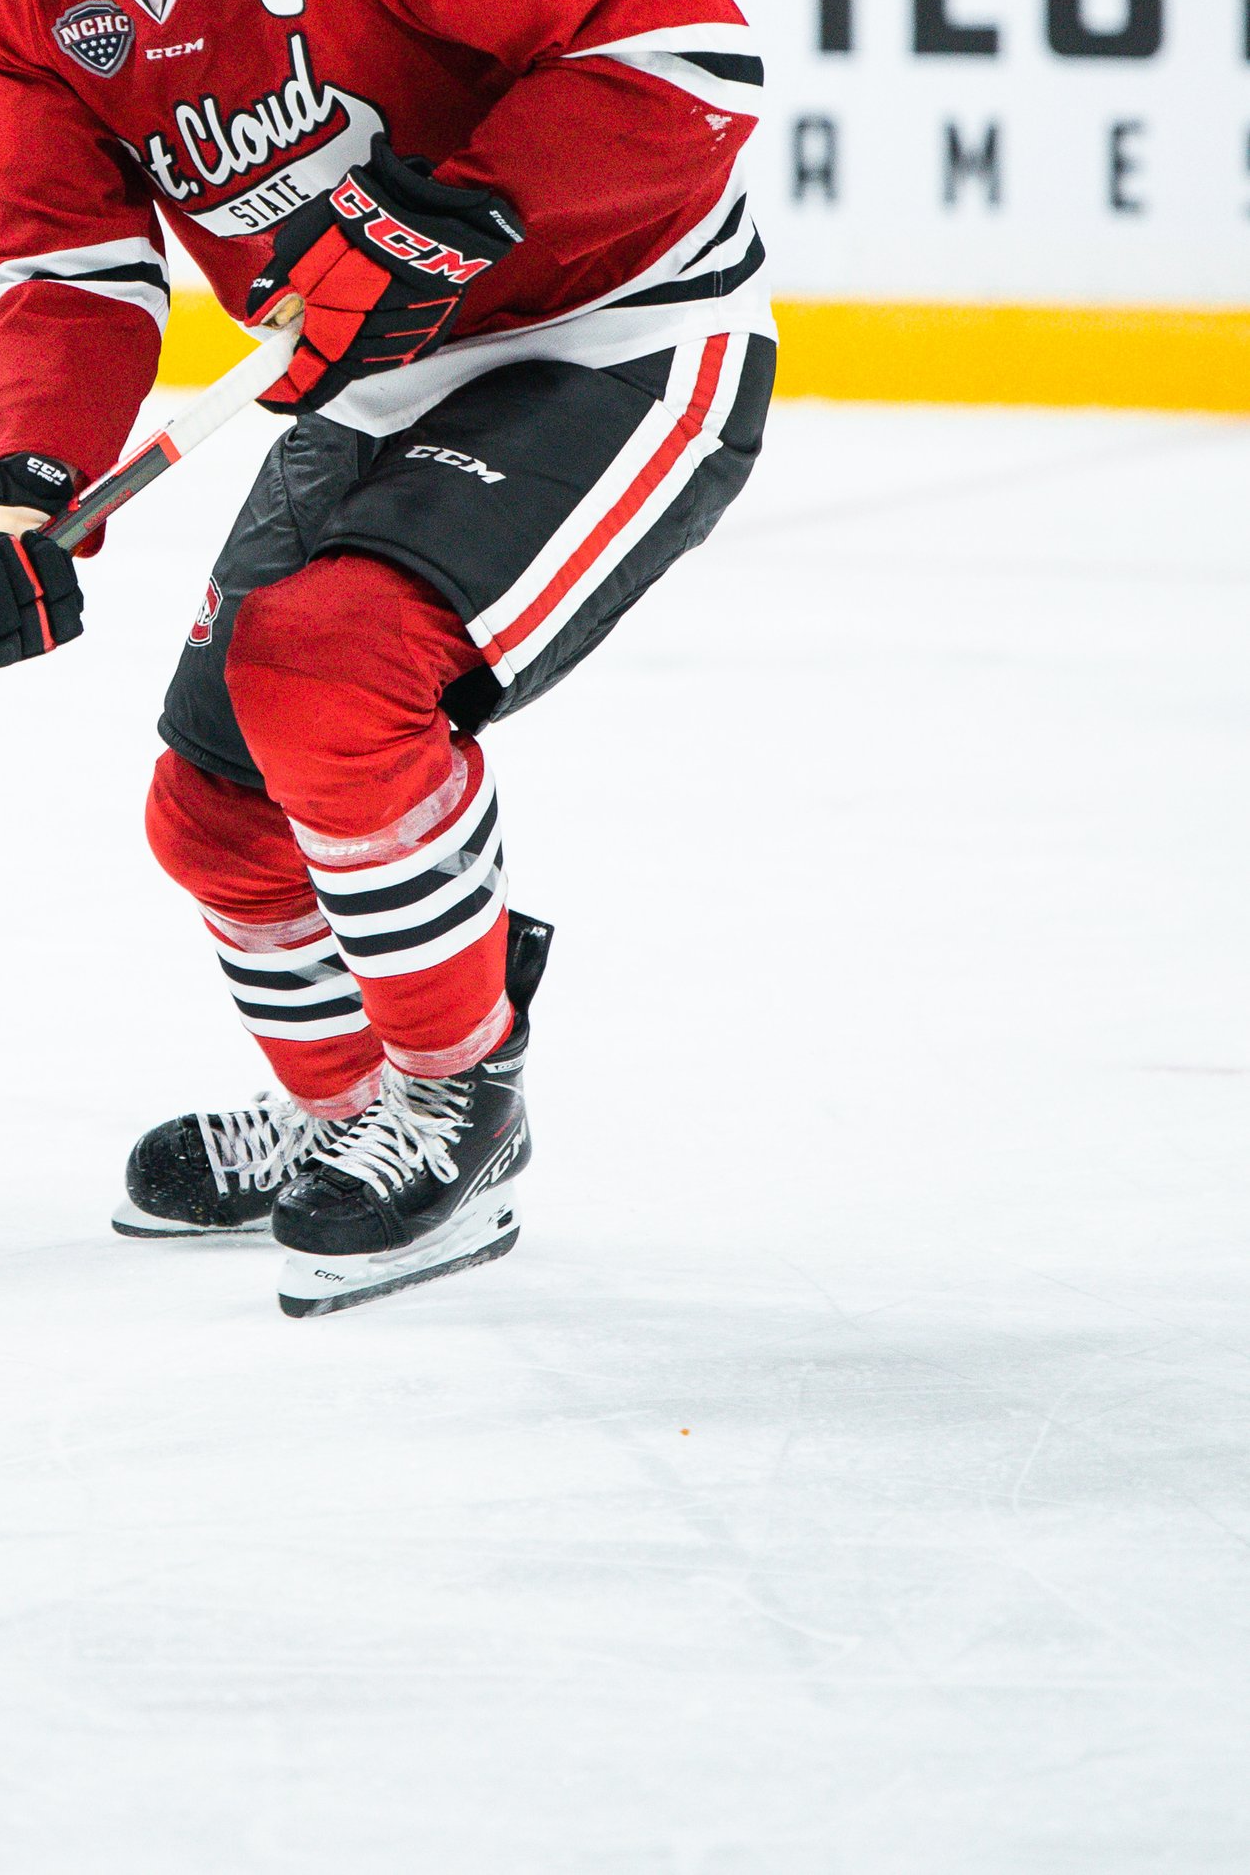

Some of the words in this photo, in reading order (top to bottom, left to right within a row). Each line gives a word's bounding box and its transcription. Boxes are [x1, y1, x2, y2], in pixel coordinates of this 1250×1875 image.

[59, 14, 130, 46] NCHC
[144, 37, 205, 61] CCM
[174, 33, 334, 187] Cloud
[788, 115, 1250, 213] AME
[228, 173, 311, 230] STATE
[329, 172, 493, 285] CCM
[250, 278, 274, 289] CM
[27, 457, 67, 482] CCM
[405, 445, 507, 484] CCM
[314, 1269, 345, 1282] CCM
